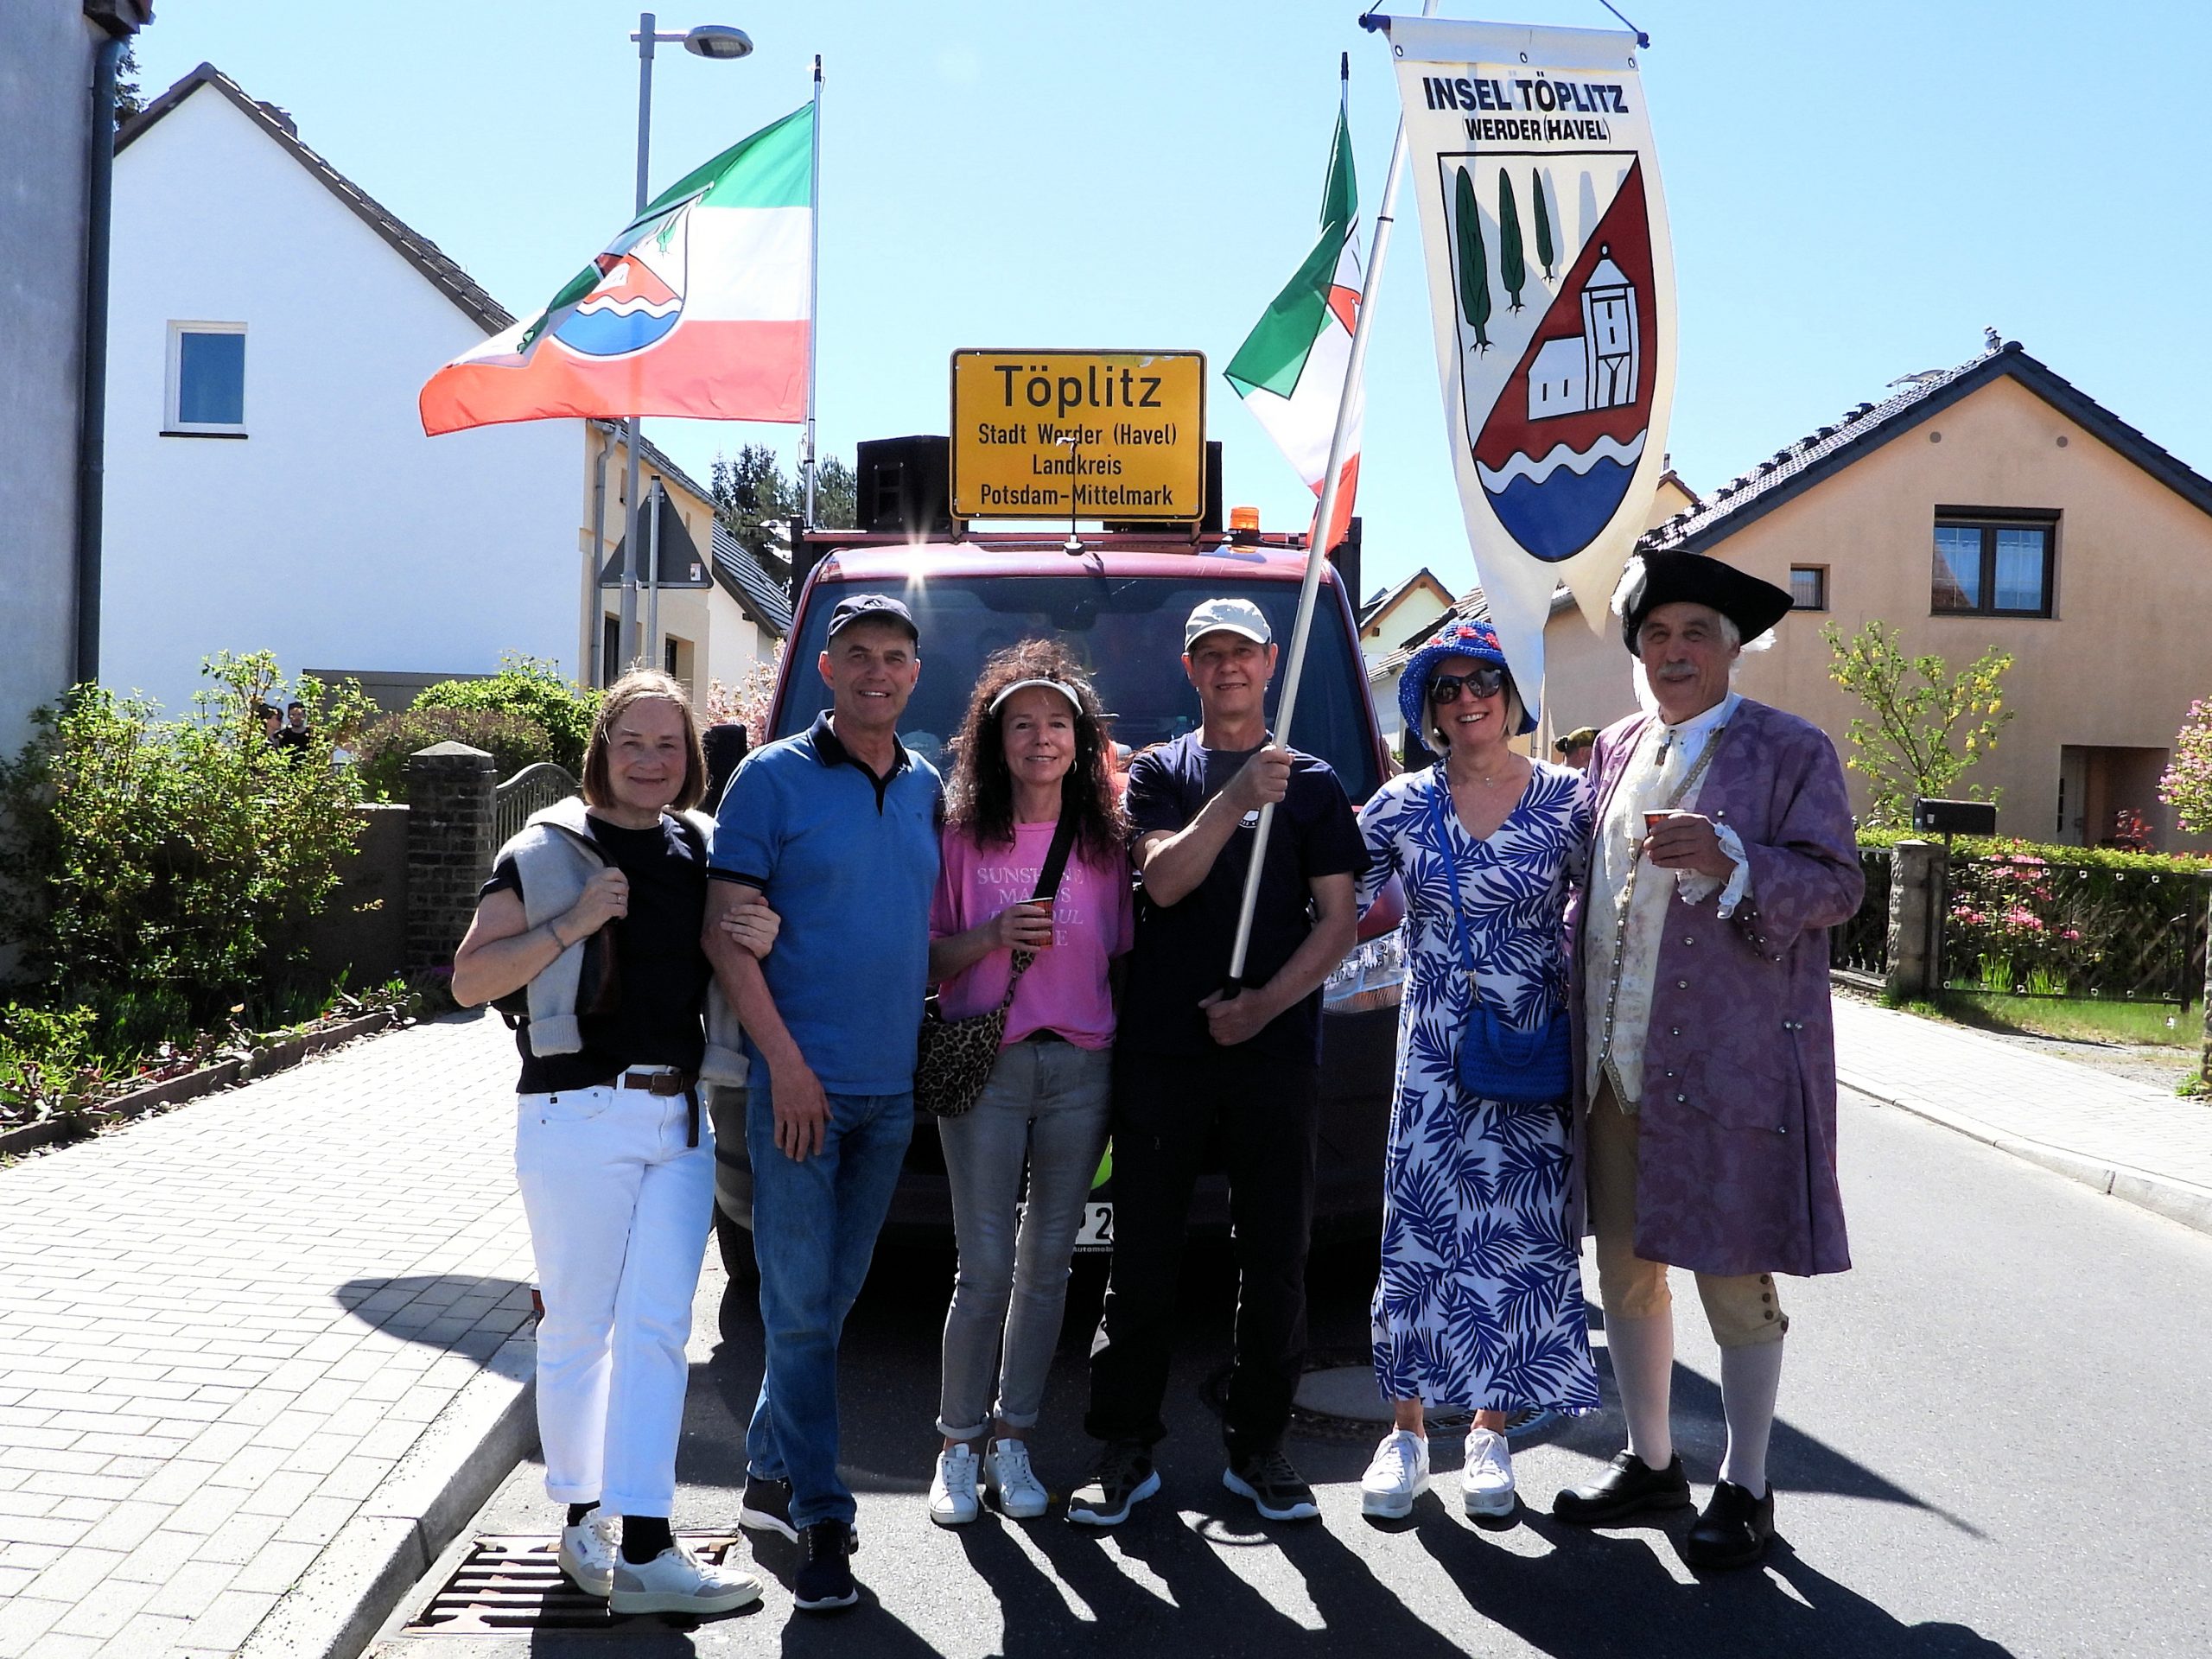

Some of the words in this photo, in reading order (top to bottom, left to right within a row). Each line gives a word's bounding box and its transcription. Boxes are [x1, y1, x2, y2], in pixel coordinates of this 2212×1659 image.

[1422, 77, 1512, 111] INSEL
[1516, 71, 1629, 113] TÖPLITZ
[994, 365, 1161, 418] Töplitz
[978, 423, 1027, 445] Stadt
[1038, 423, 1103, 445] Werder
[1114, 423, 1176, 447] (Havel)
[1033, 454, 1122, 475] Landkreis
[981, 484, 1173, 505] Potsdam-Mittelmark
[977, 867, 1084, 885] SUNSHNE
[999, 887, 1071, 905] MAS
